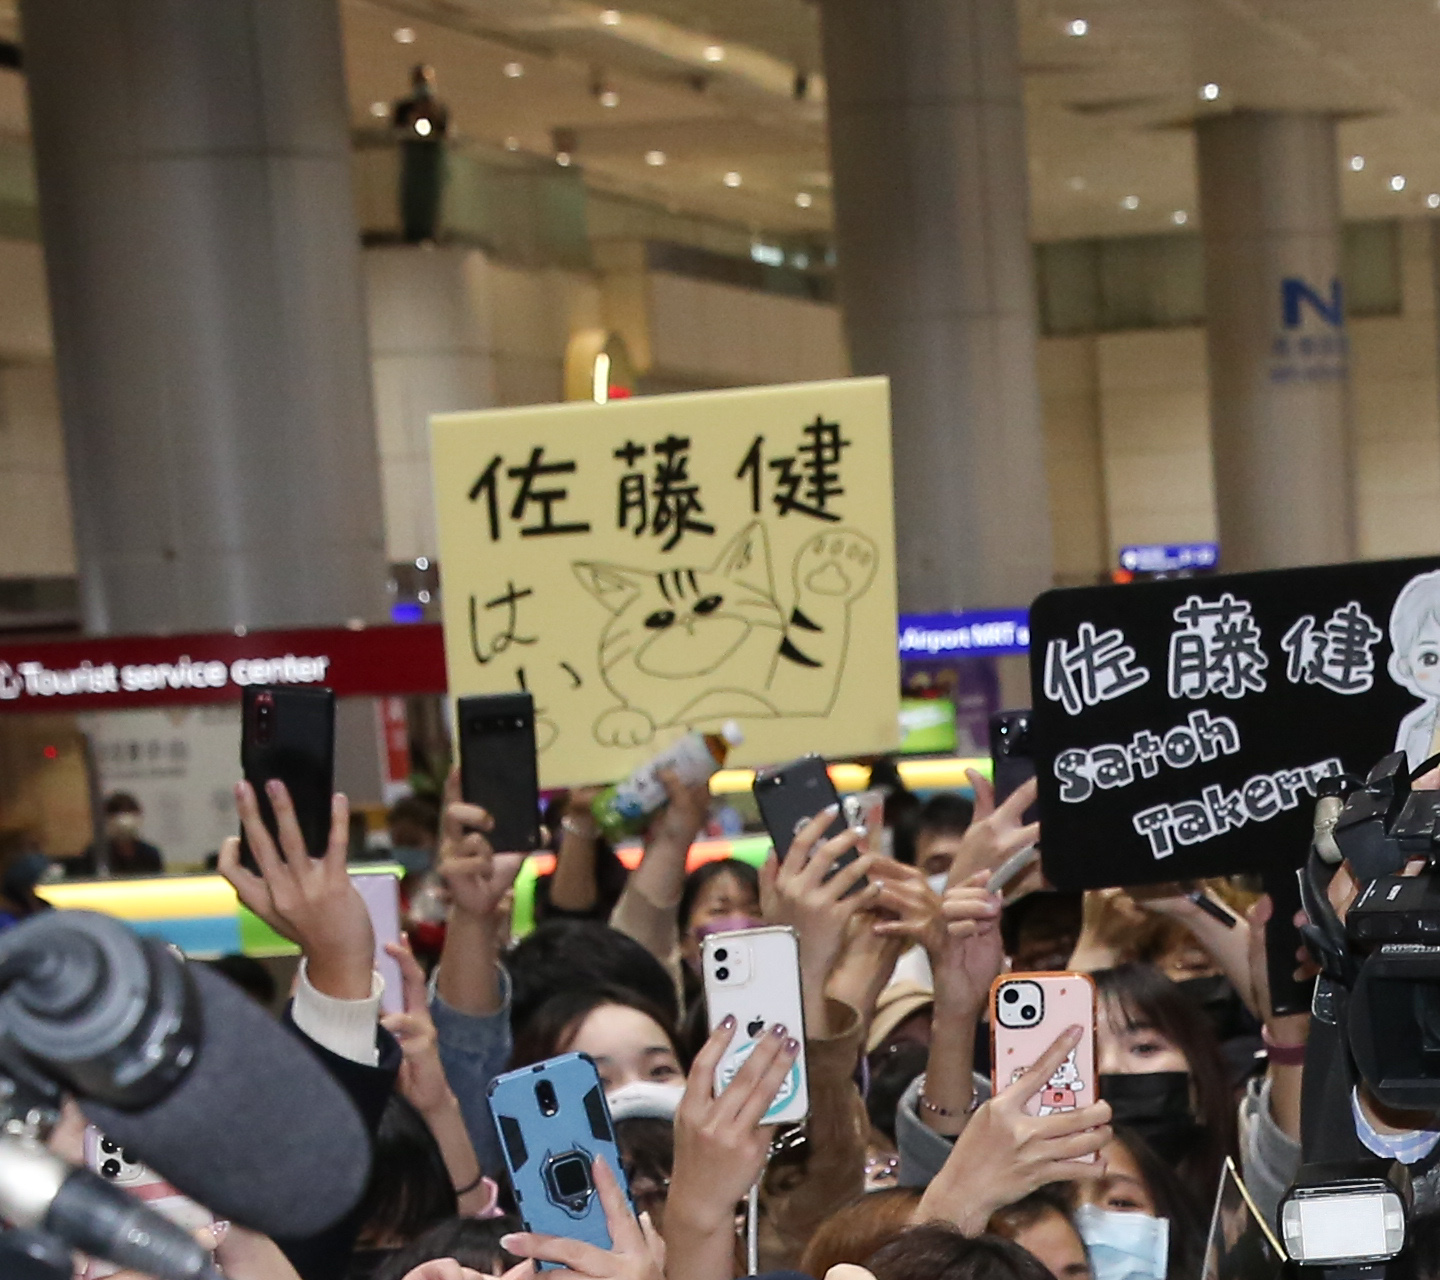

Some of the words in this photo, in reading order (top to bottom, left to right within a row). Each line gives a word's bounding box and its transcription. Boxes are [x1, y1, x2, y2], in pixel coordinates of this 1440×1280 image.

[468, 414, 852, 552] 佐藤健
[18, 660, 119, 696] Tourist
[122, 656, 228, 692] service
[230, 653, 329, 686] center
[1044, 594, 1382, 716] 佐藤健
[1054, 710, 1240, 802] Satoh
